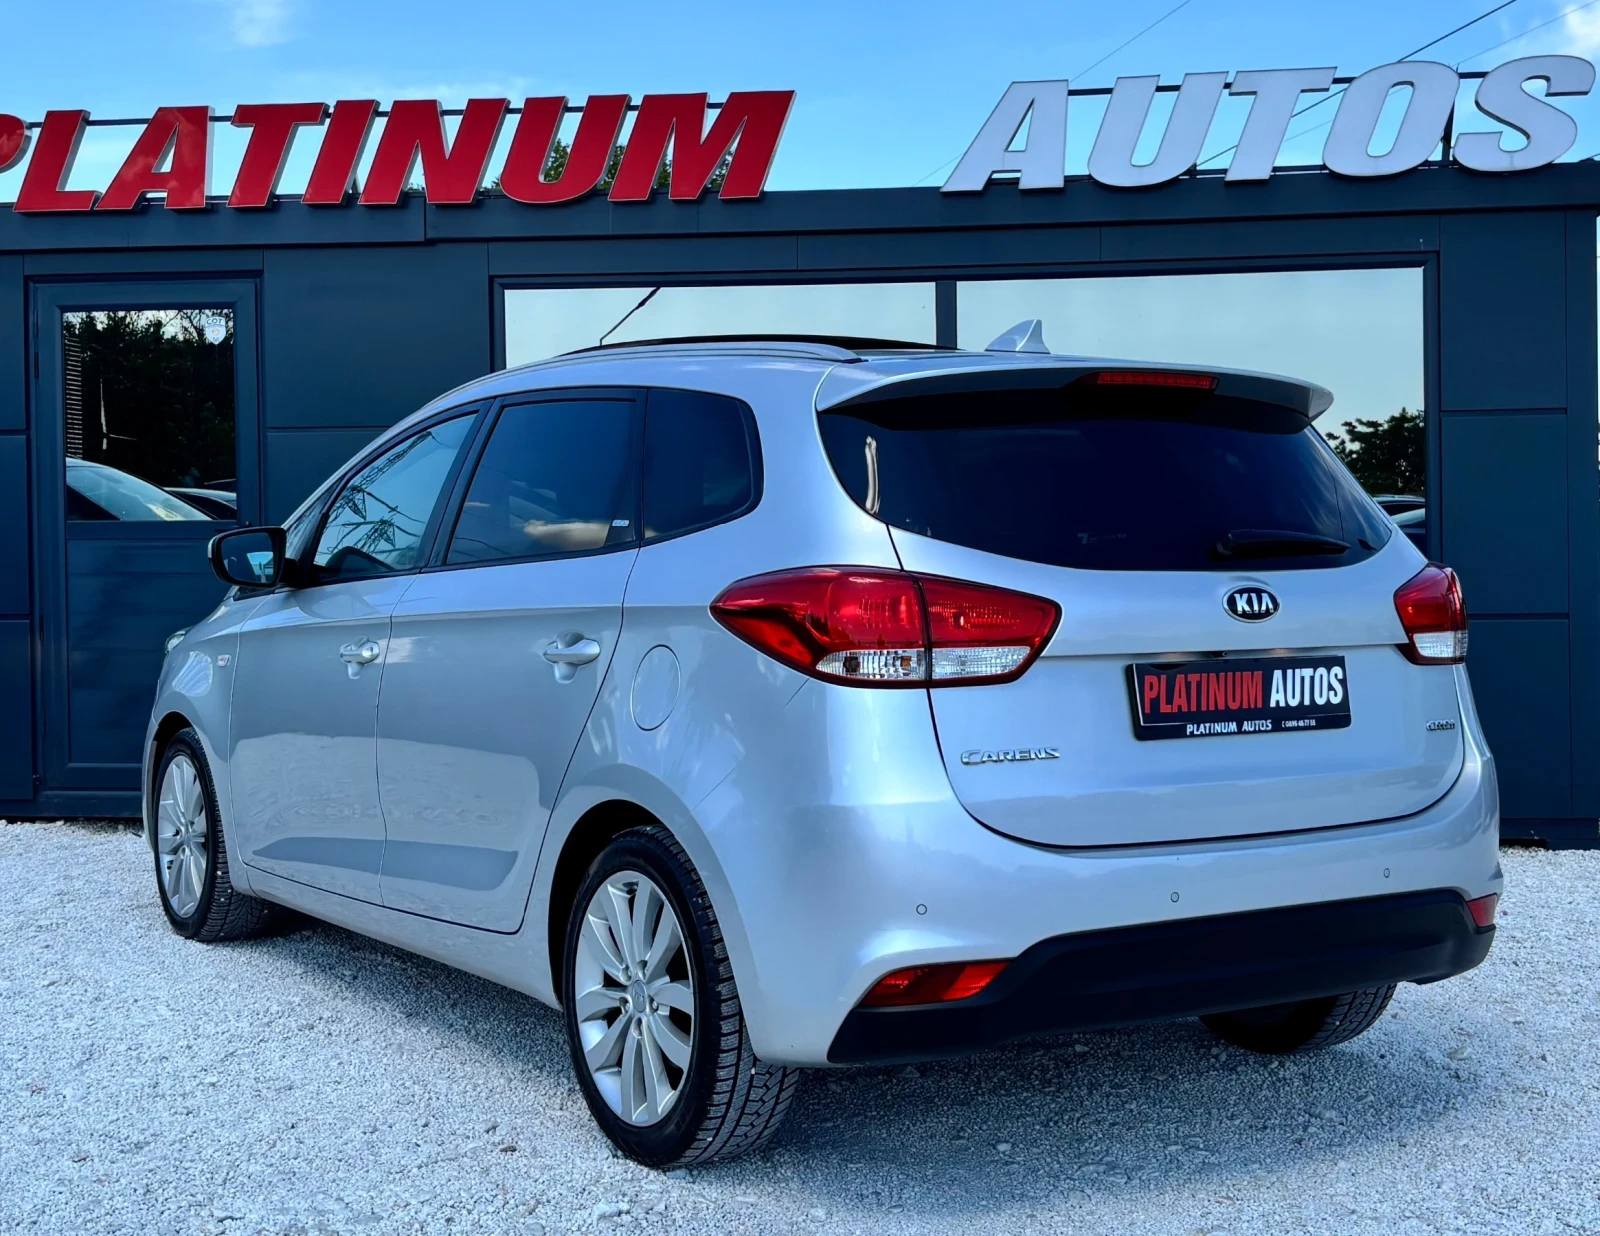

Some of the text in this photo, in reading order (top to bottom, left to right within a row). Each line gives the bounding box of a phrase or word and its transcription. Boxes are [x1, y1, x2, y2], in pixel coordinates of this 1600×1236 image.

[940, 54, 1597, 193] AUTOS
[1234, 592, 1274, 614] KIA
[1144, 666, 1344, 714] PLATINUM AUTOS
[1186, 721, 1238, 736] PLATINUM
[1241, 719, 1273, 733] AUTOS
[961, 747, 1060, 765] CARENS
